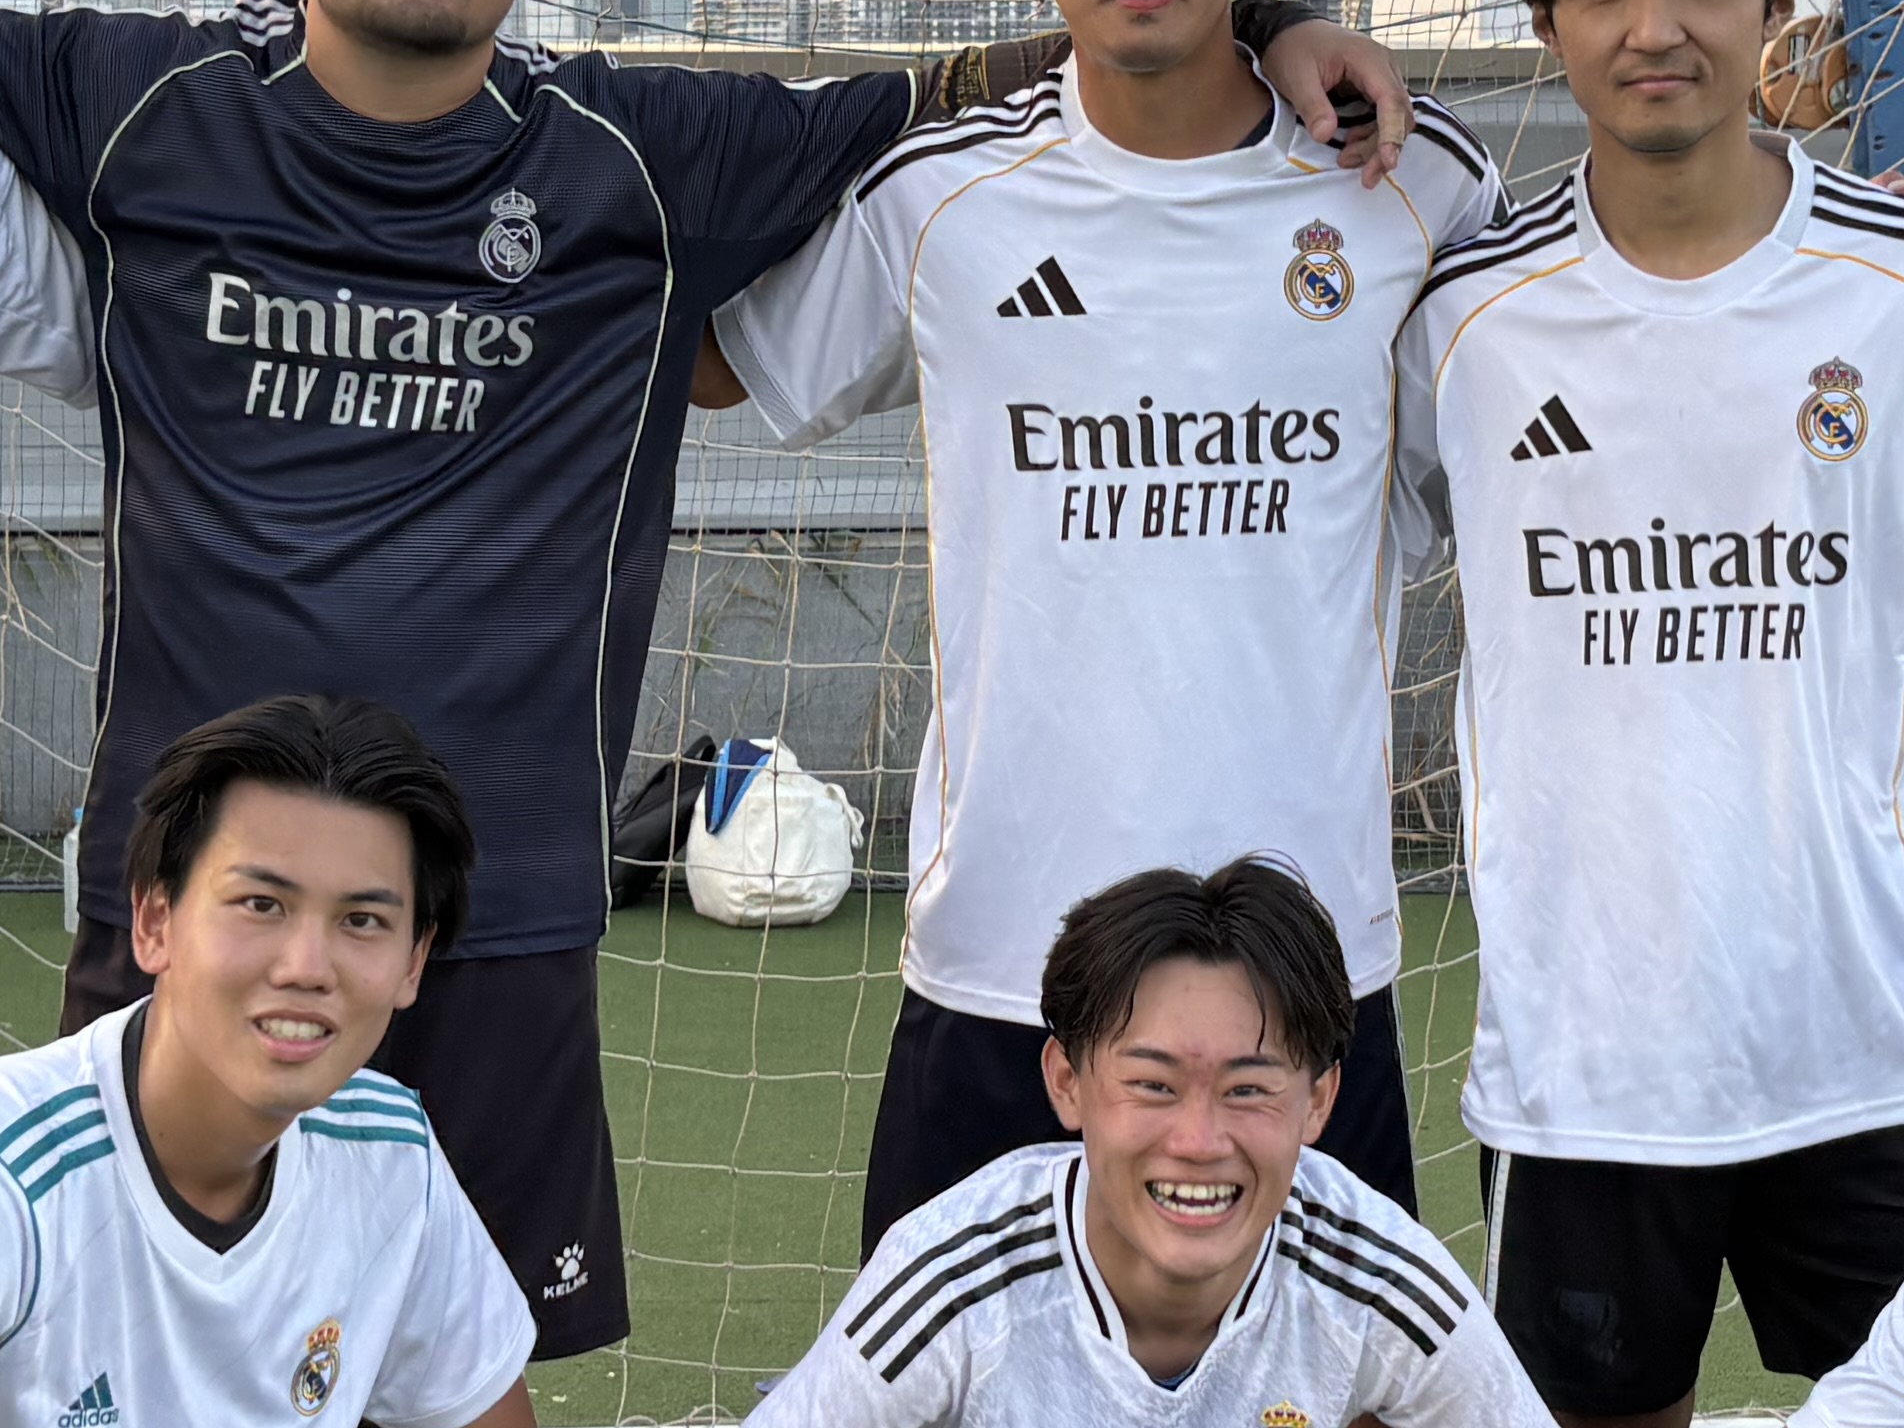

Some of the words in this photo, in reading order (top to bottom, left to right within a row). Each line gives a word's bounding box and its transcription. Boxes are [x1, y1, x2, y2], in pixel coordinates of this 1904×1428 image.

[206, 272, 535, 367] Emirates
[245, 360, 321, 421] FLY
[330, 370, 485, 433] BETTER
[1006, 395, 1341, 472] Emirates
[1060, 483, 1128, 542] FLY
[1142, 478, 1290, 538] BETTER
[1522, 517, 1850, 598] Emirates
[1583, 606, 1639, 666] FLY
[1655, 602, 1805, 664] BETTER
